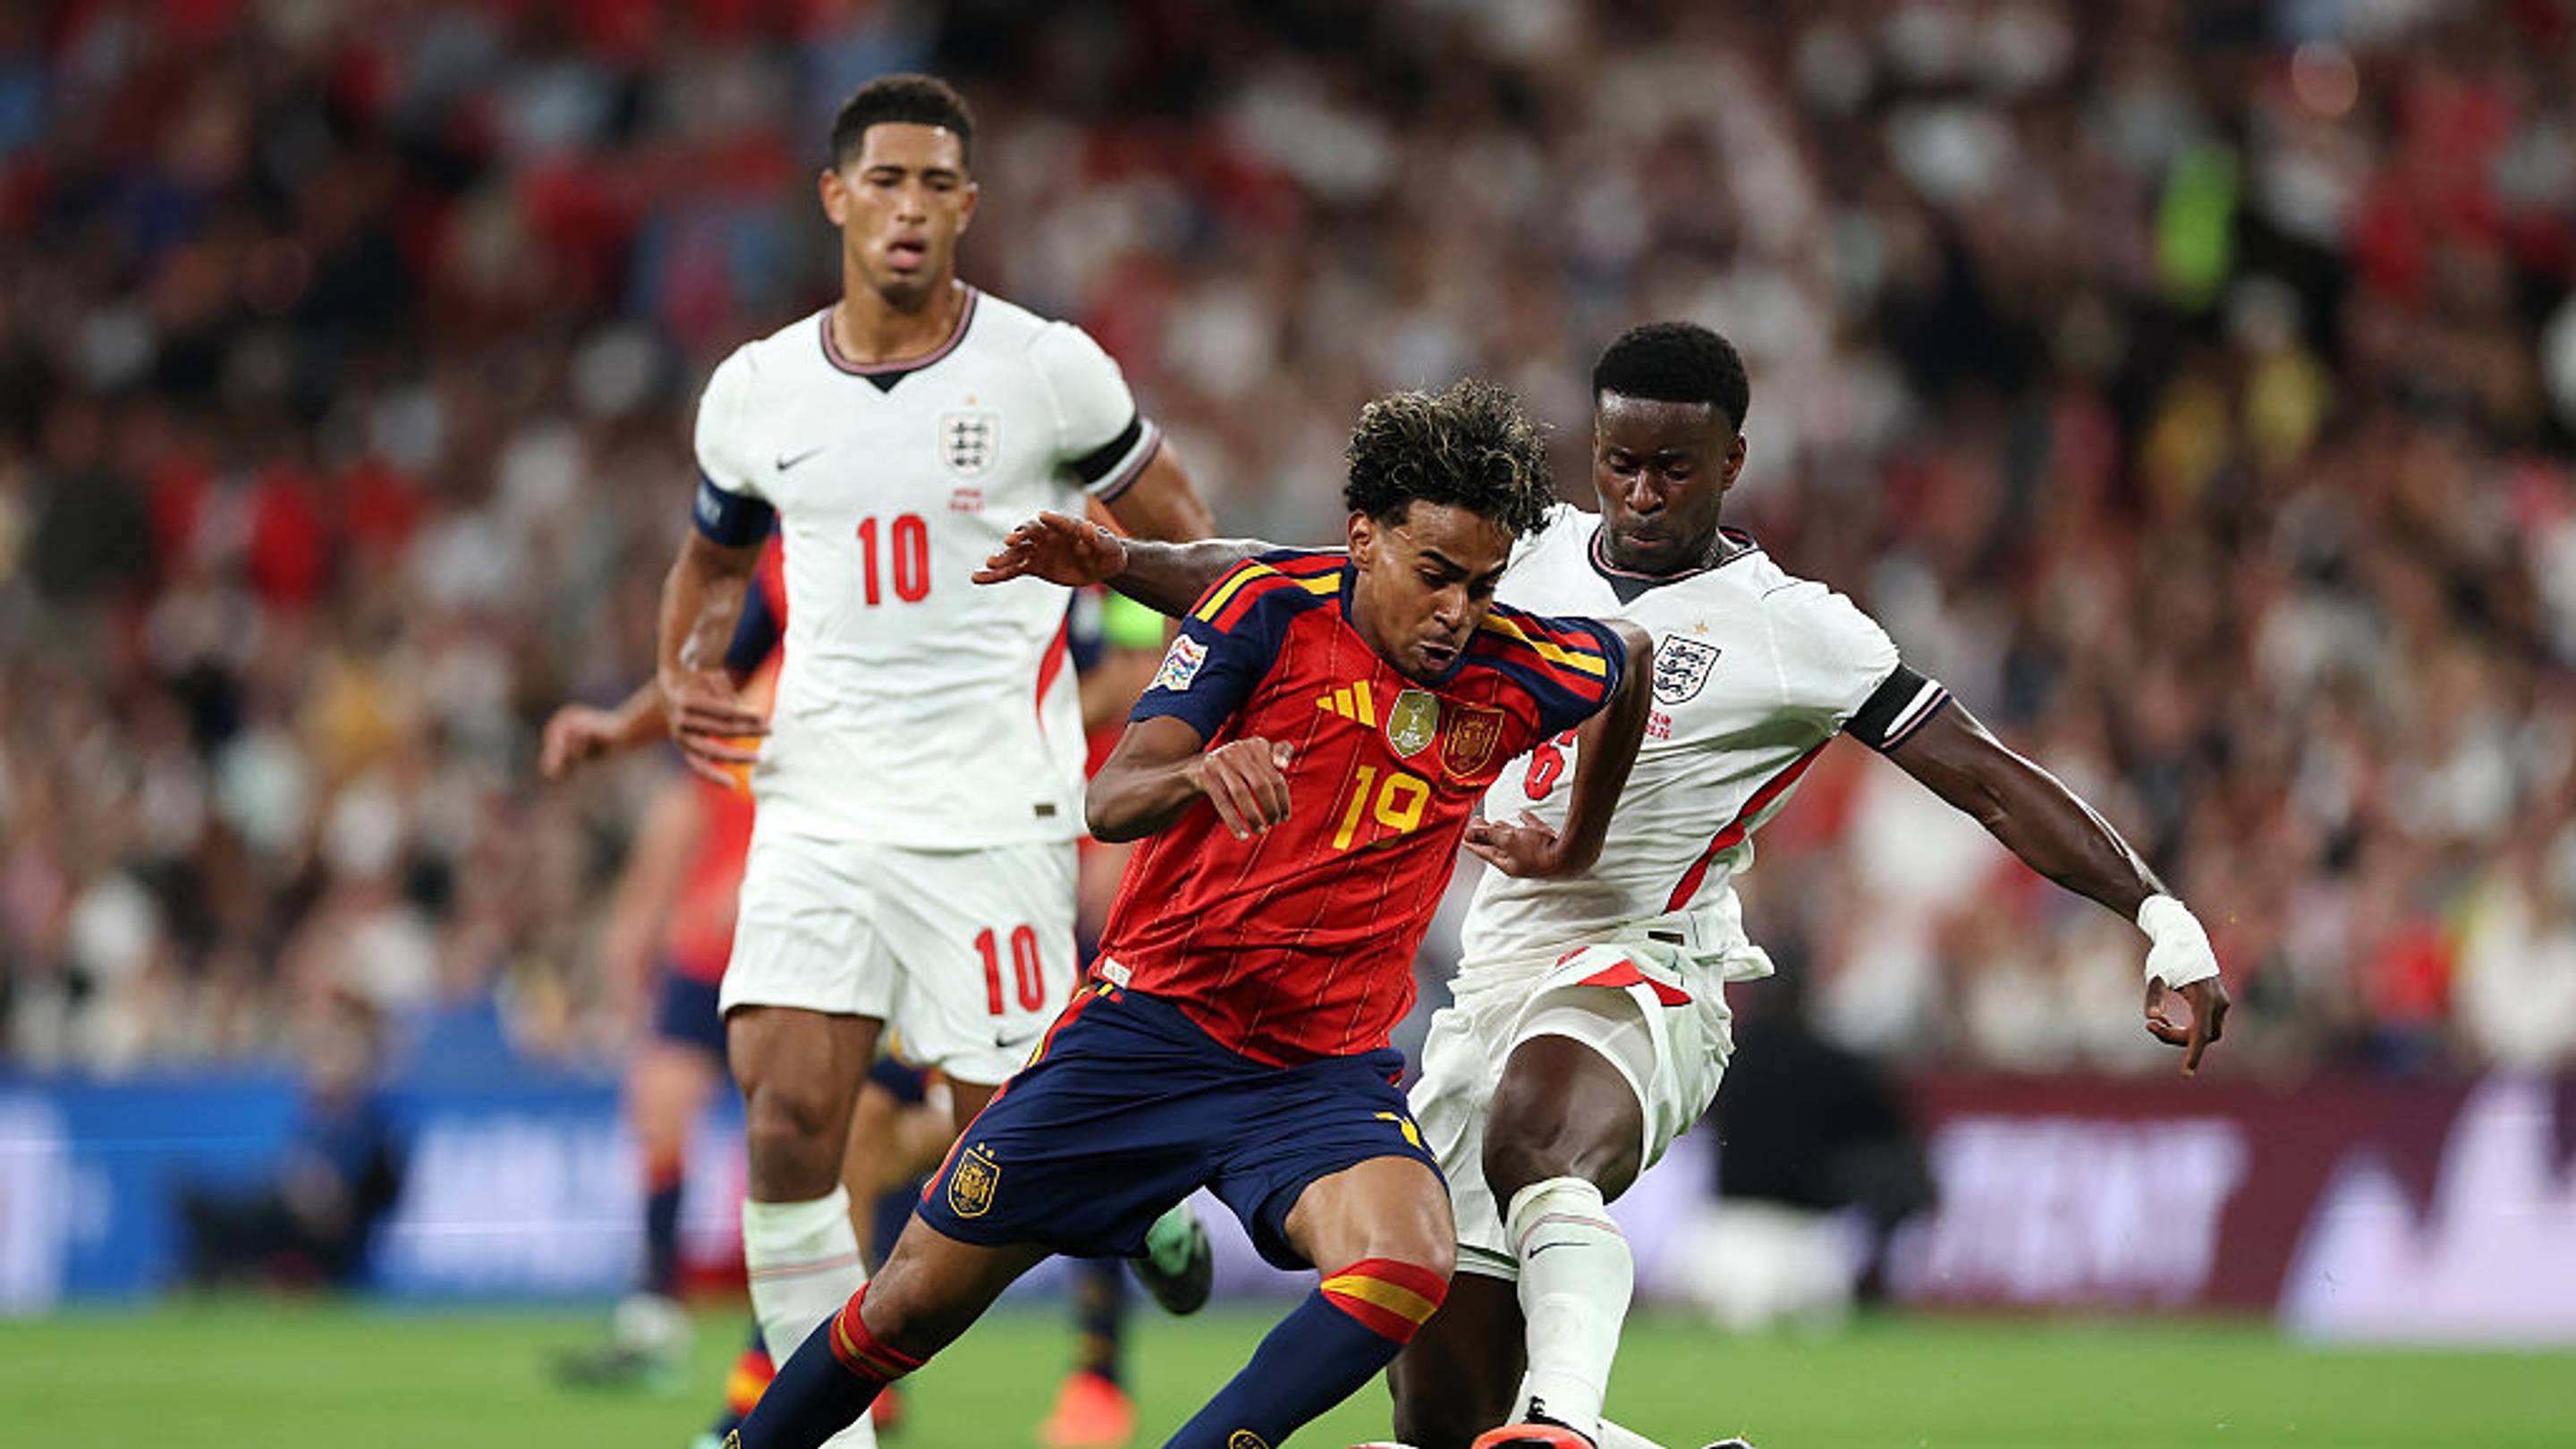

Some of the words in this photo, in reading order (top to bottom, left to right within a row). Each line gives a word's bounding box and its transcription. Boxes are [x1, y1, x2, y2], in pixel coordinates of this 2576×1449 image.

[857, 513, 930, 606] 10
[1333, 765, 1430, 851] 19
[1524, 728, 1579, 801] 6
[974, 925, 1045, 1015] 10
